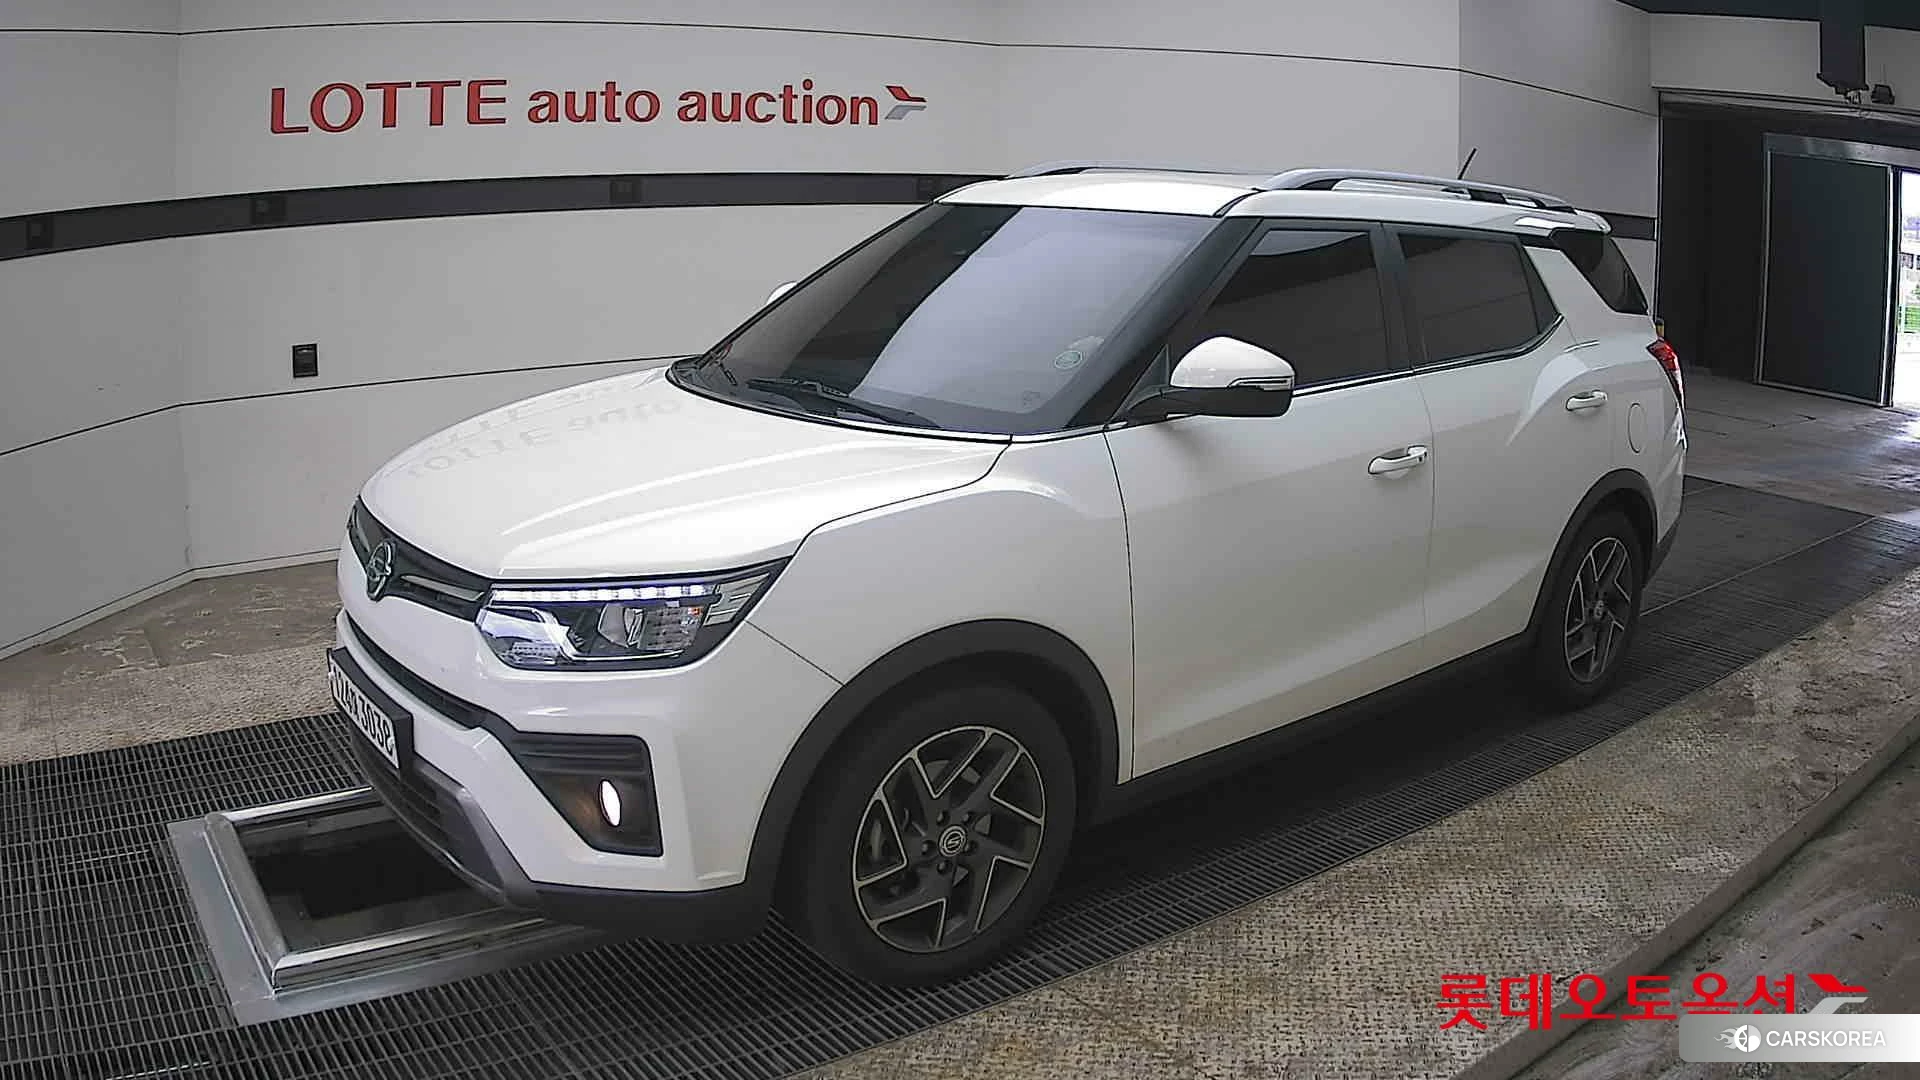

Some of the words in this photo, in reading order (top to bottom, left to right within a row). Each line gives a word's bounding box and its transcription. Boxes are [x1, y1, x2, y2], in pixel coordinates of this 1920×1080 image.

[270, 79, 508, 134] LOTTE
[527, 81, 661, 125] auto
[676, 79, 879, 126] auction
